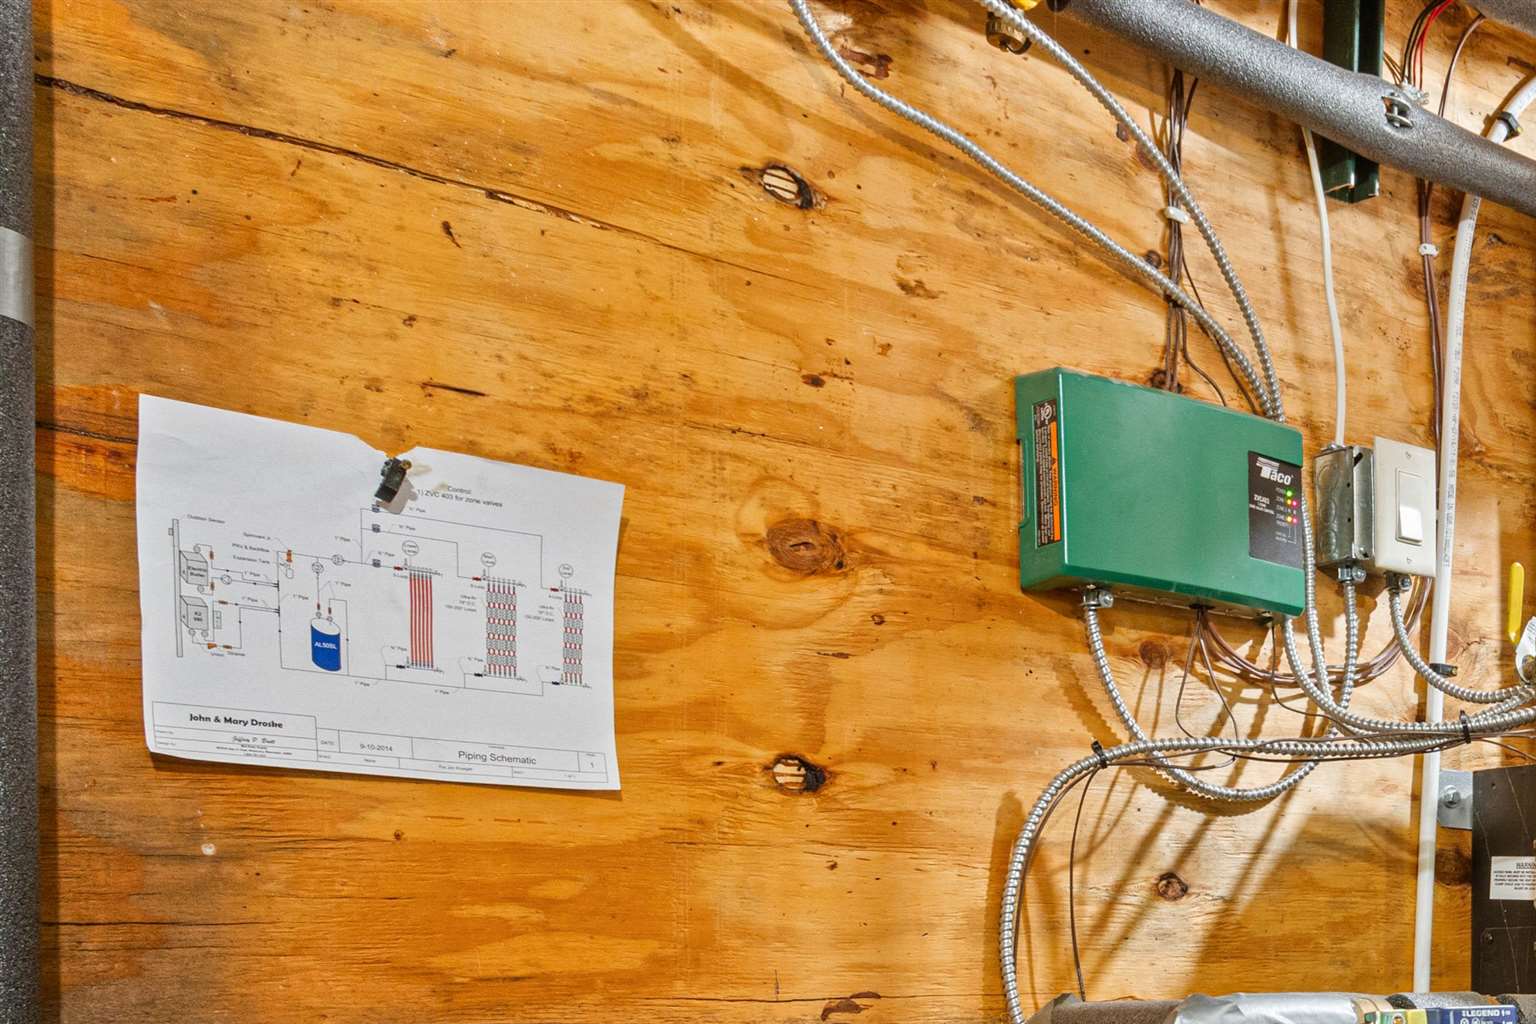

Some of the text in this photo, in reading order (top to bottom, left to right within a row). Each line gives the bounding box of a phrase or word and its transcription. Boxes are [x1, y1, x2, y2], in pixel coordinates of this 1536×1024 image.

[189, 713, 212, 723] John
[213, 715, 221, 724] &
[224, 716, 248, 727] Mary
[458, 750, 536, 765] Piping Schematic
